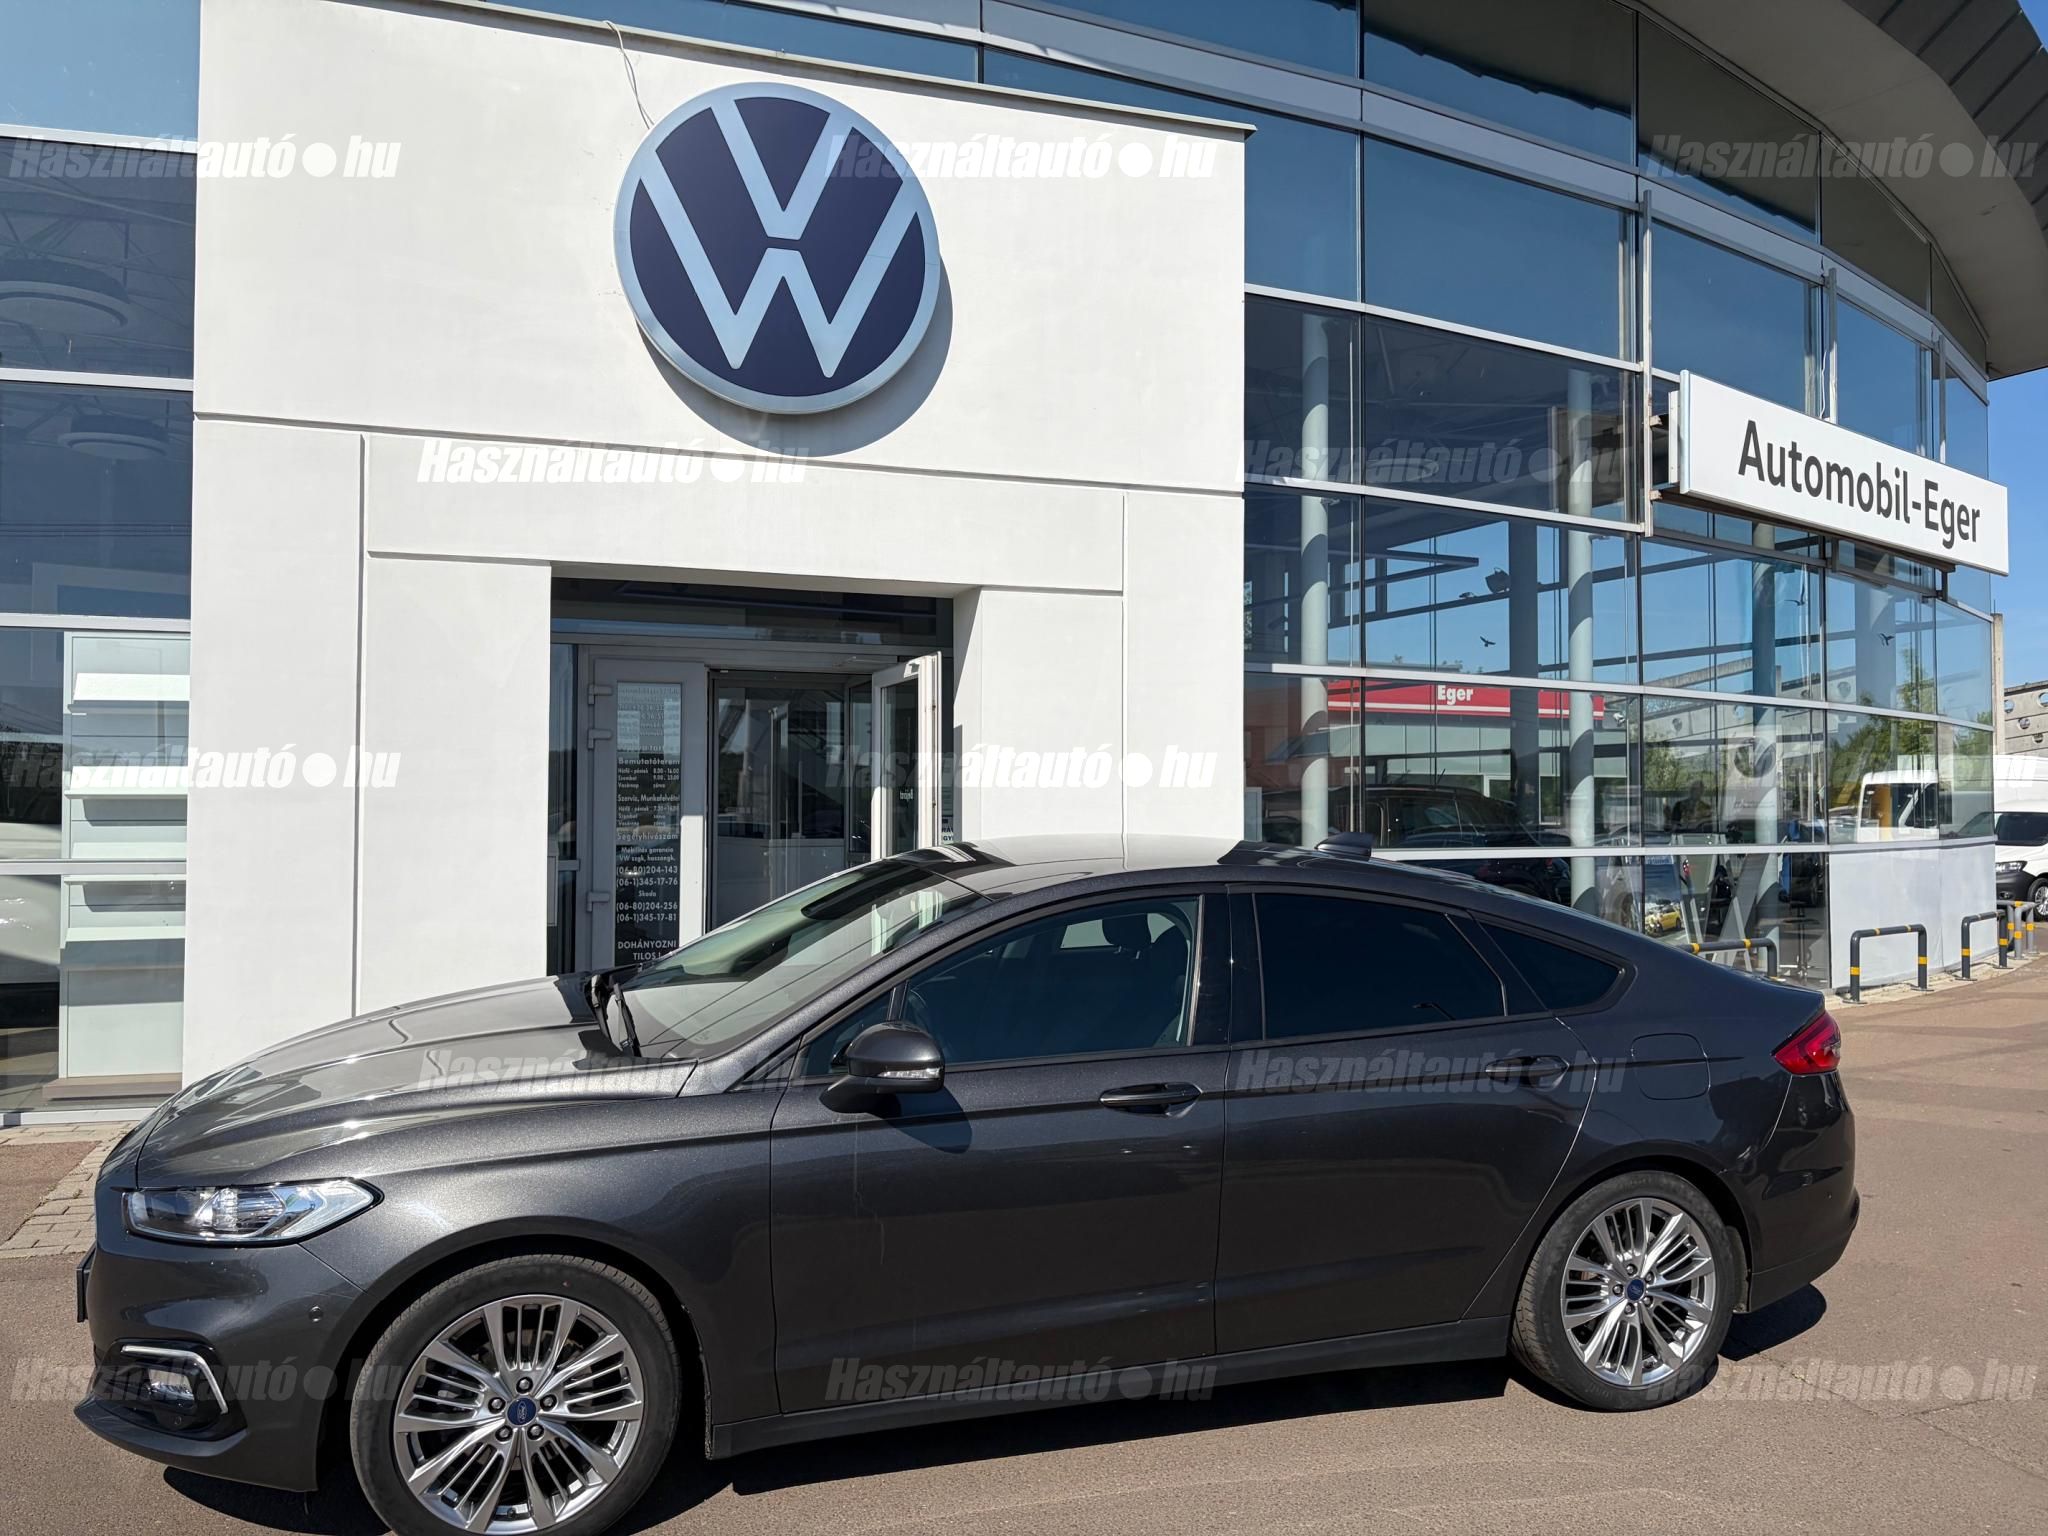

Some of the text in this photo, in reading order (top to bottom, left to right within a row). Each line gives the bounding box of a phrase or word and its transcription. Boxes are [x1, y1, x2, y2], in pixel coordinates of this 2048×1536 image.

[1738, 419, 1981, 550] Automobil-Eger
[1437, 684, 1474, 706] Eger
[616, 877, 678, 888] (06-1)345-17-76
[616, 901, 678, 912] (06-80)204-256
[616, 913, 677, 923] (06-1)345-17-81
[617, 938, 677, 949] DOHÁNYOZNI
[632, 952, 656, 960] TILOS
